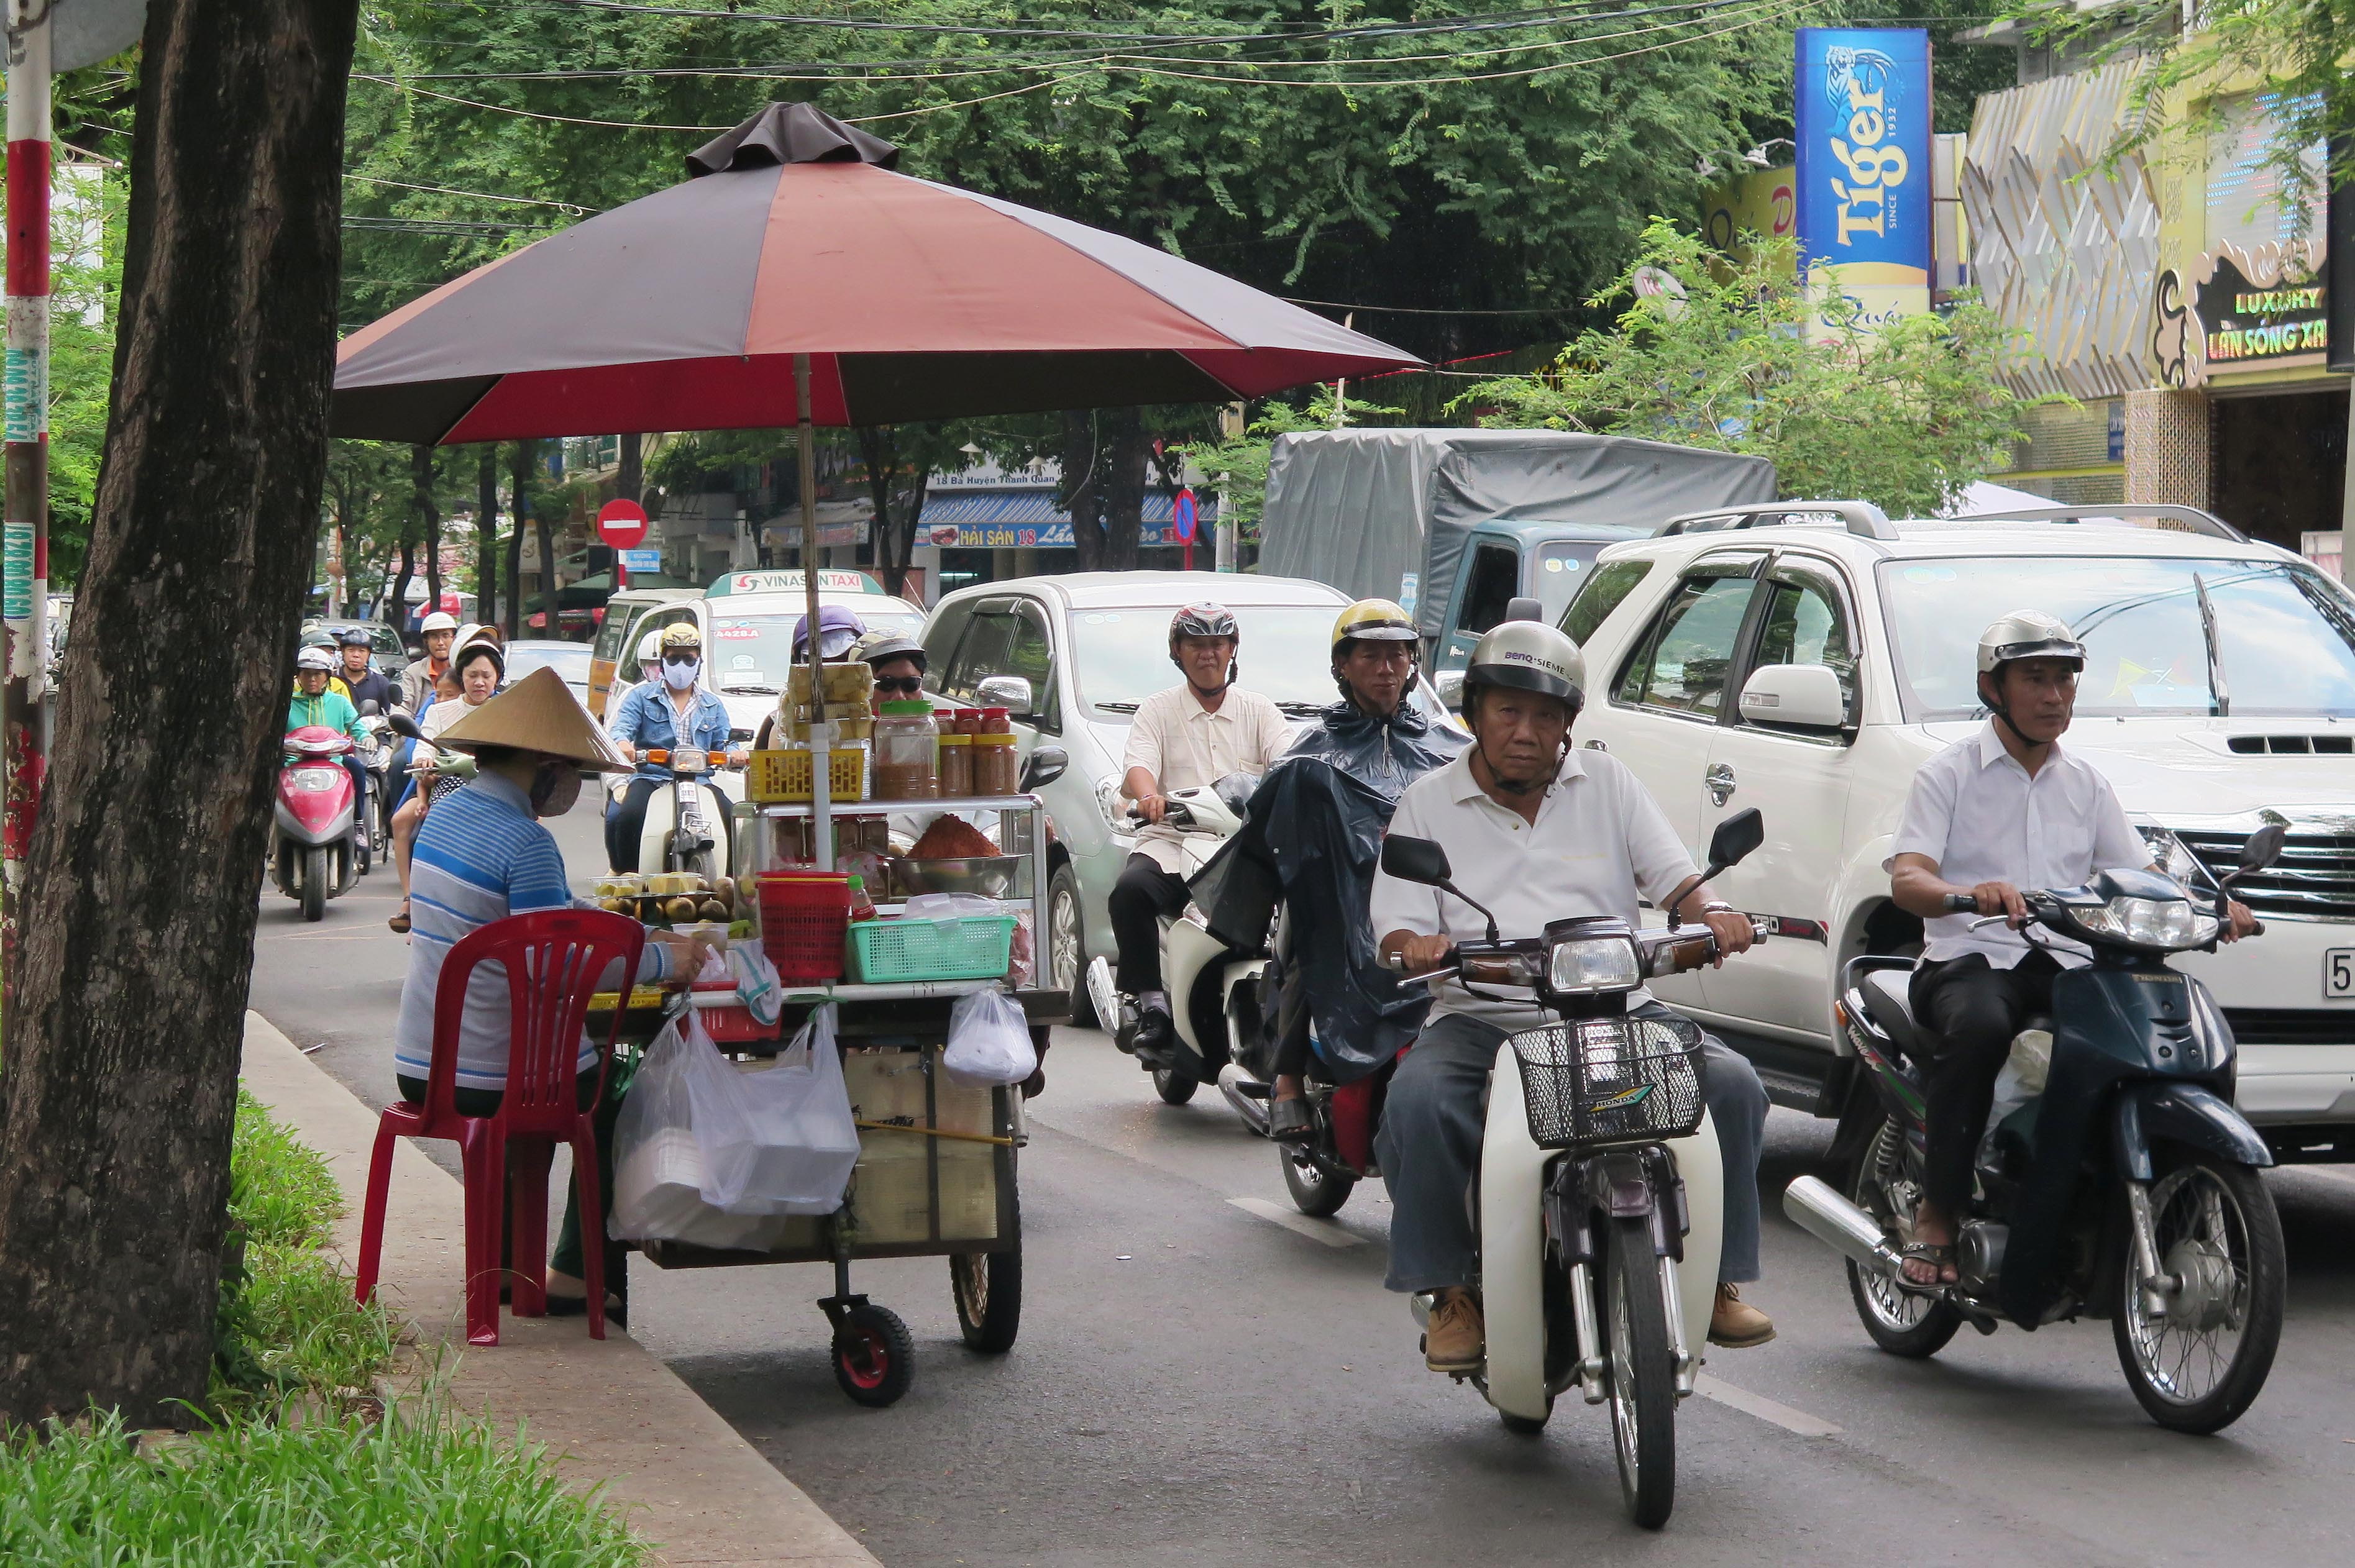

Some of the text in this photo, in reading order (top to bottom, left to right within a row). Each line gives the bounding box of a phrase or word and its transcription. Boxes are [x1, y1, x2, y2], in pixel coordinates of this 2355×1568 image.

[1831, 78, 1908, 247] Tiger
[1888, 107, 1898, 229] SINCE 1932
[960, 525, 983, 545] HẢI
[987, 525, 1014, 545] SẢN
[1018, 529, 1036, 545] 18
[1597, 1095, 1636, 1108] HONDA
